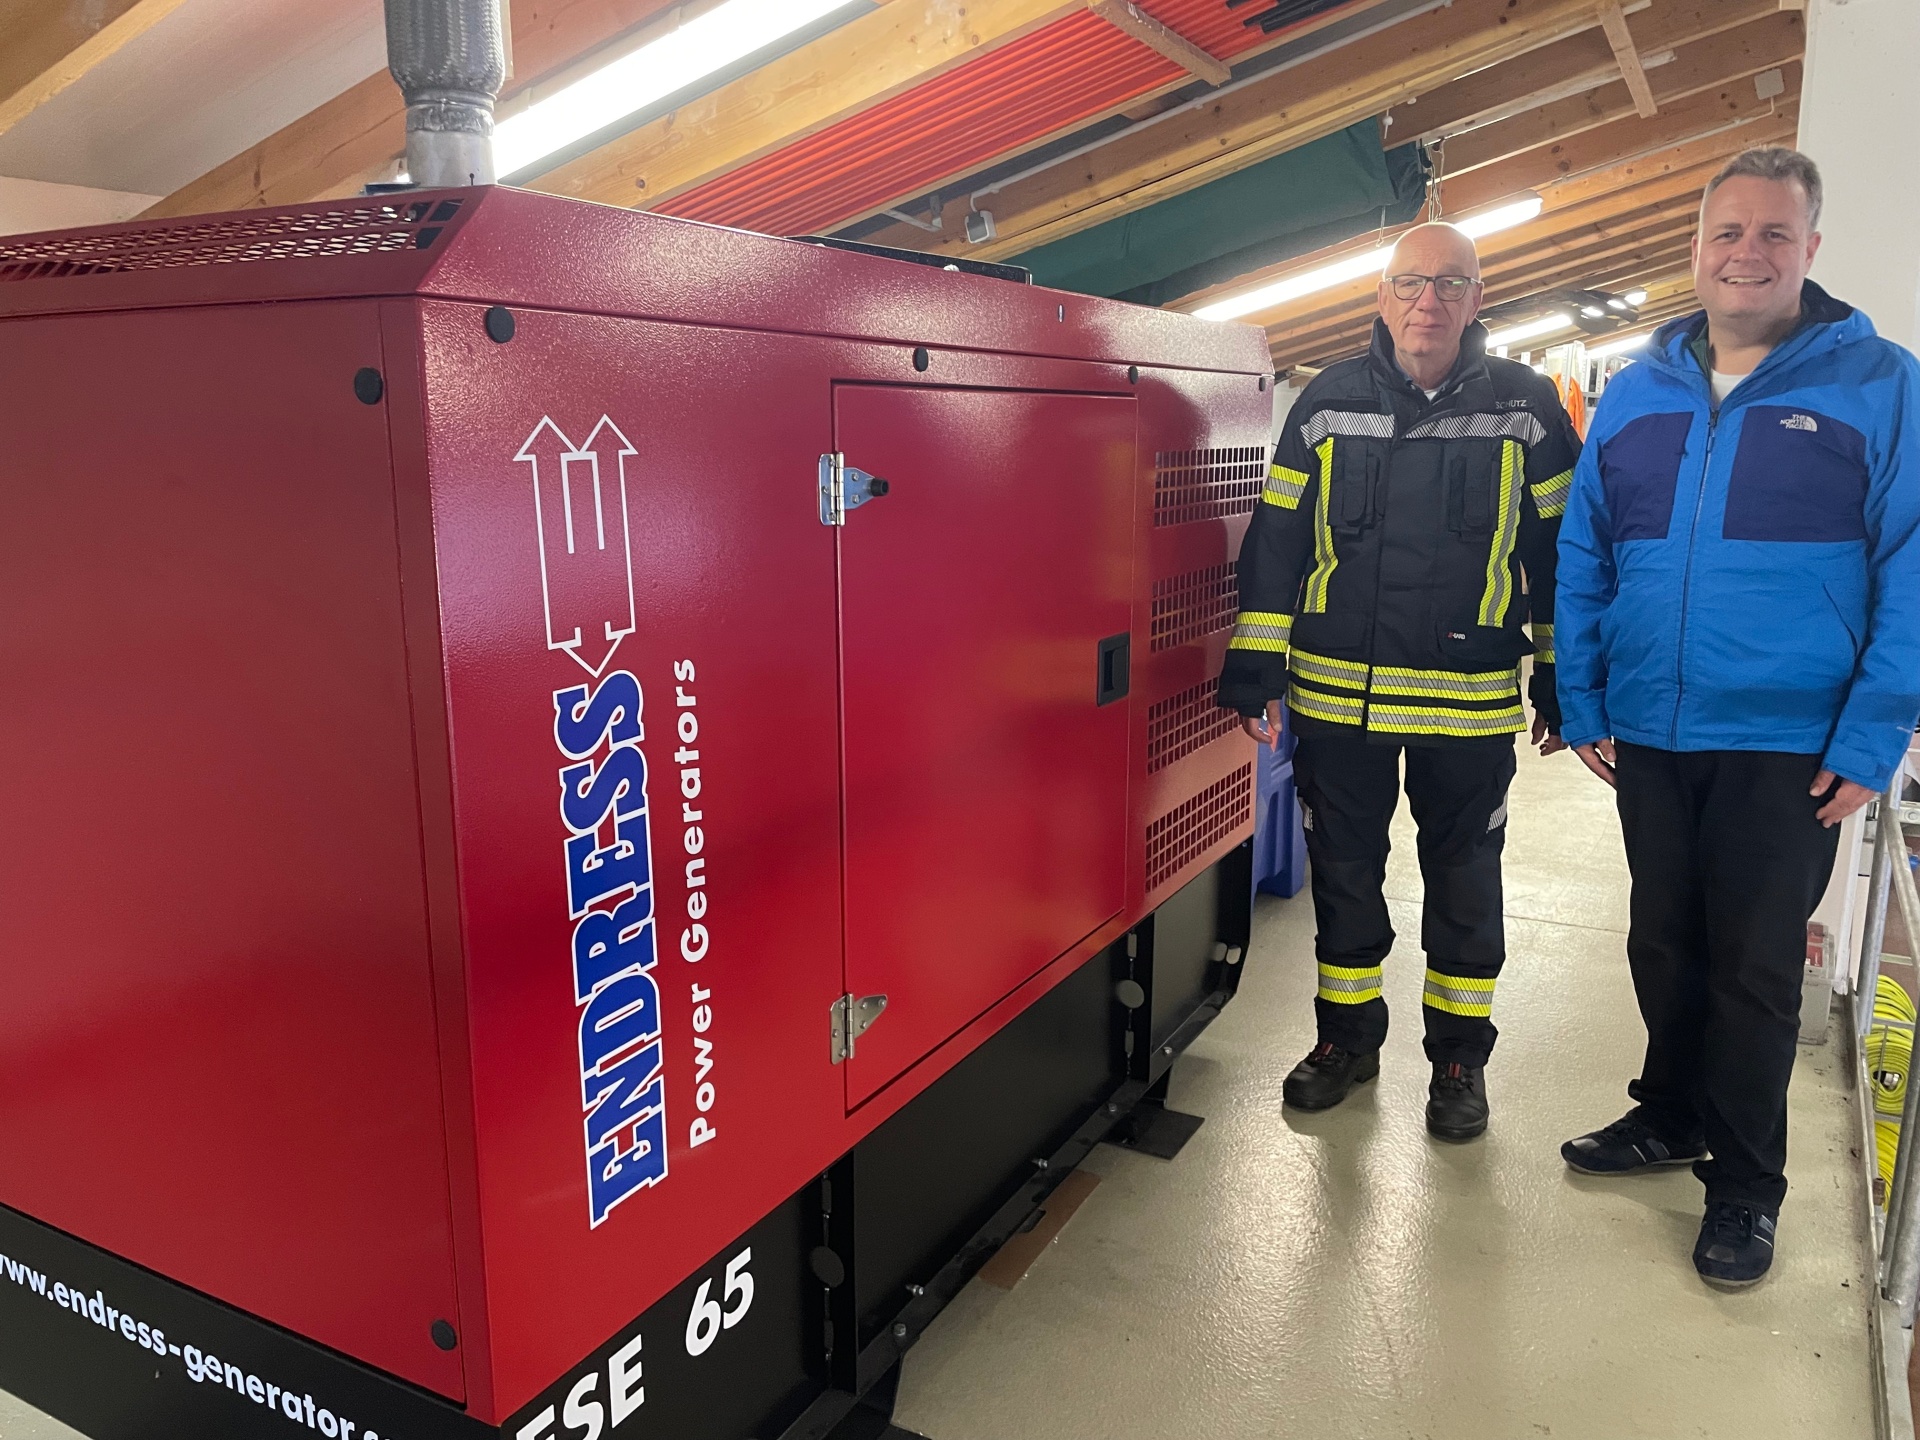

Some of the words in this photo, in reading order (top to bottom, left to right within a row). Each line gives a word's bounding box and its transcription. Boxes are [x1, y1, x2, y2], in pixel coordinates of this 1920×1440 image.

[673, 658, 710, 963] Generators
[553, 669, 668, 1231] ENDRESS
[690, 982, 717, 1149] Power
[685, 1246, 754, 1357] 65
